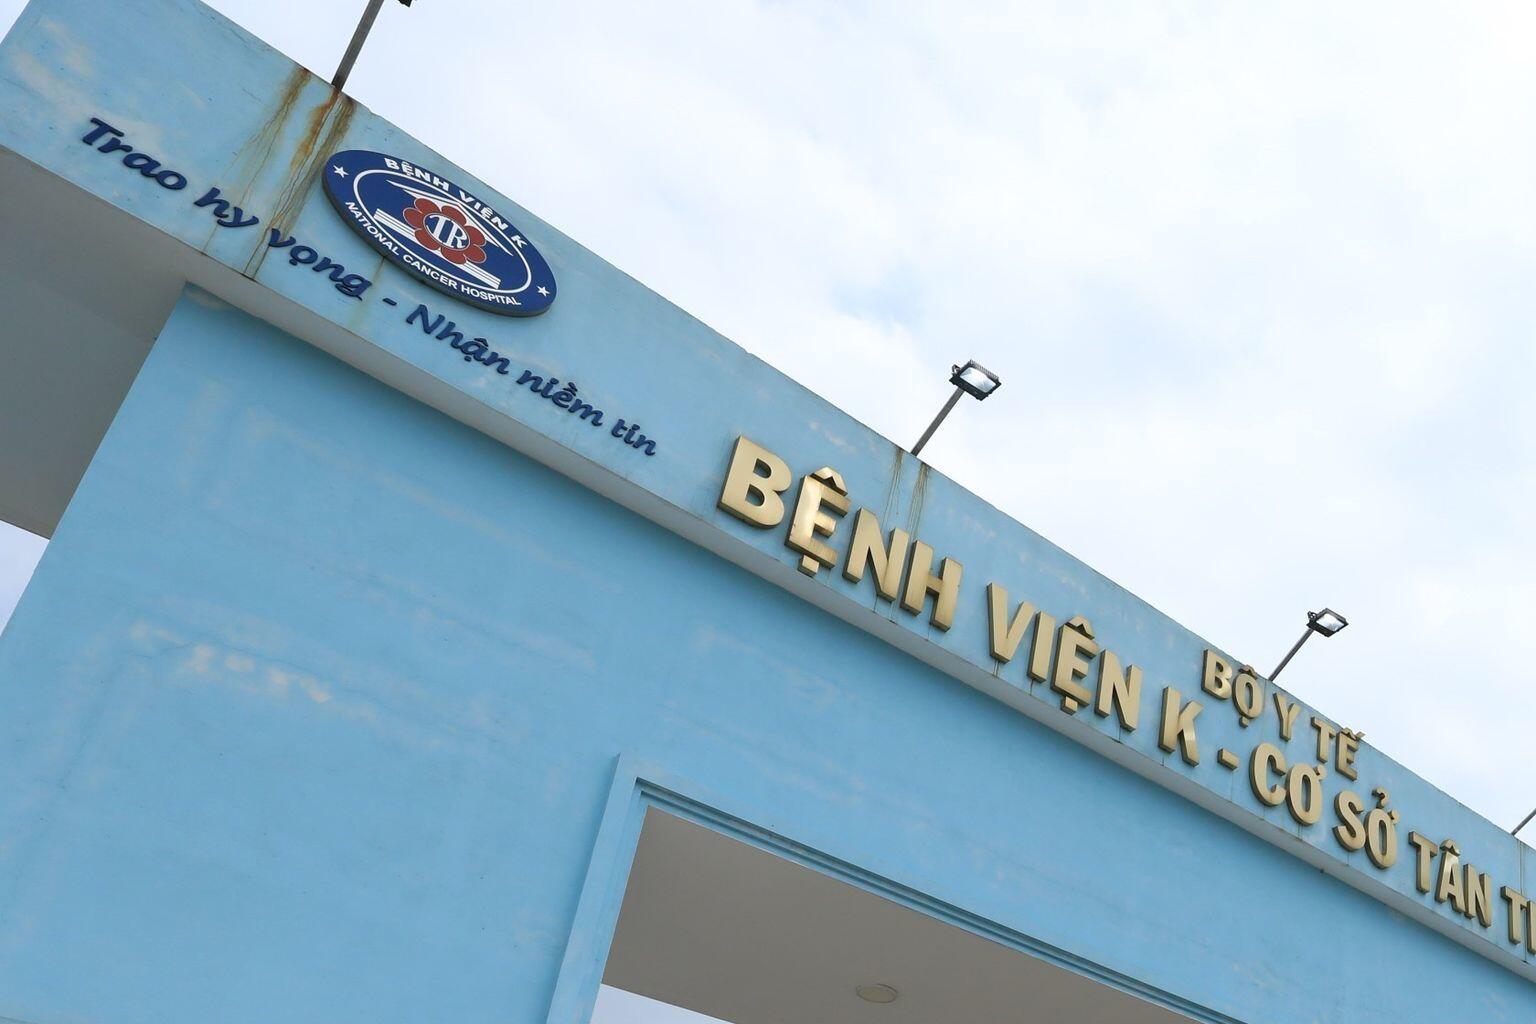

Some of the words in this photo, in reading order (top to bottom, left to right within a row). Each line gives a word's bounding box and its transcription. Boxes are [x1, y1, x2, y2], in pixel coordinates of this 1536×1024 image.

[345, 201, 400, 256] NATIONAL
[403, 254, 458, 290] CANCER
[461, 284, 522, 306] HOSPITAL
[384, 157, 449, 191] BỆNH
[459, 190, 508, 231] VIỆN
[511, 235, 528, 248] K
[81, 117, 188, 191] Trao
[194, 187, 258, 228] hy
[268, 227, 373, 302] vọng
[406, 303, 511, 375] Nhận
[517, 369, 603, 426] niềm
[611, 416, 656, 456] tin
[717, 436, 963, 631] BỆNH
[986, 583, 1142, 732] VIỆN
[1158, 686, 1202, 766] K
[1250, 743, 1326, 825] CƠ
[1333, 787, 1400, 869] SỞ
[1408, 831, 1492, 927] TÂN
[1201, 649, 1263, 728] BỘ
[1273, 692, 1301, 741] Y
[1311, 716, 1365, 781] TẾ
